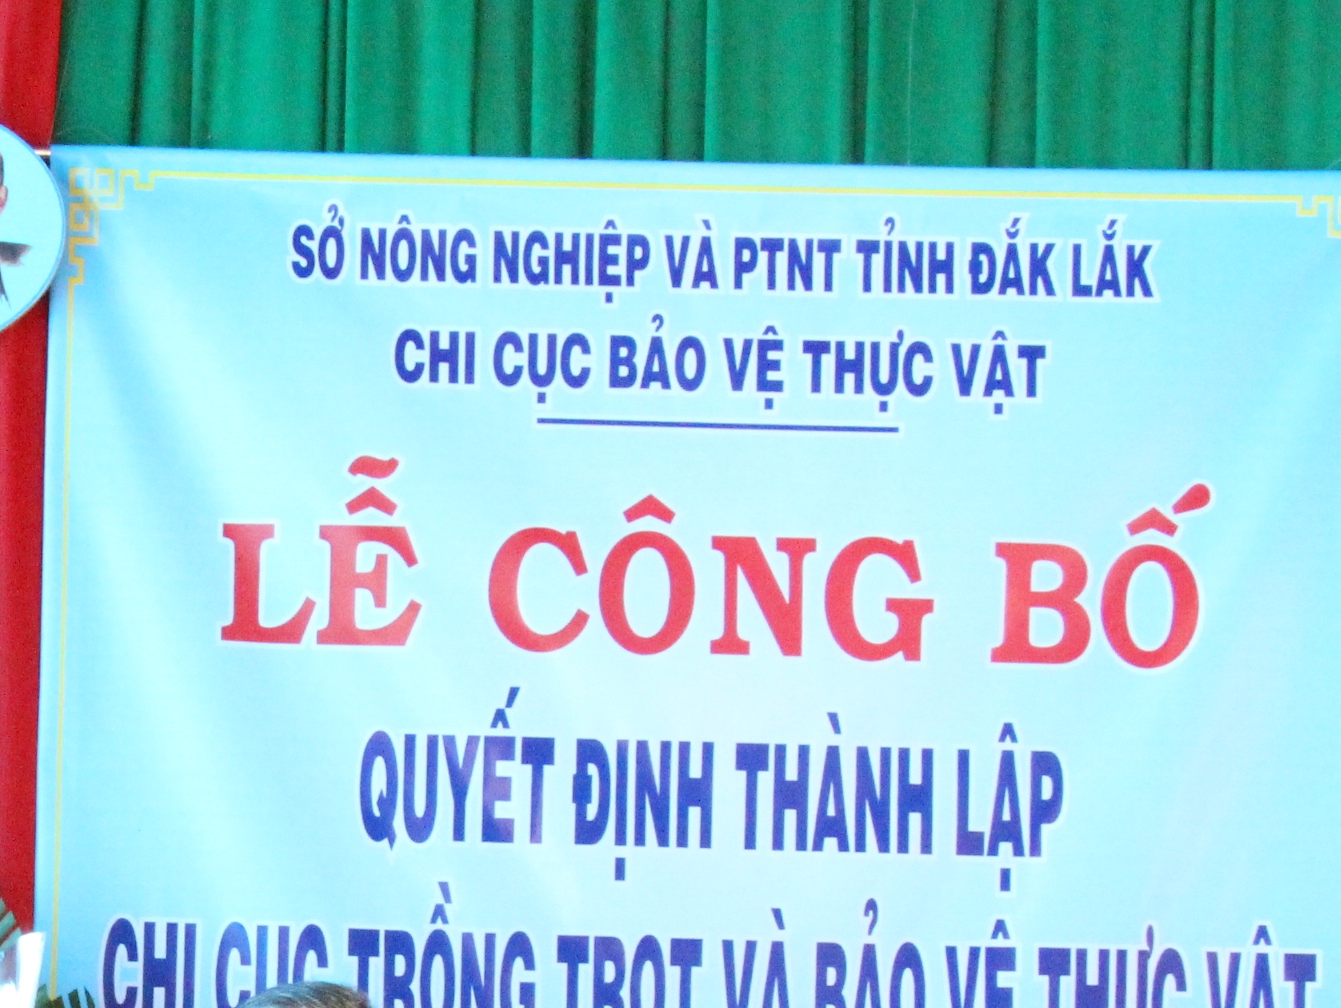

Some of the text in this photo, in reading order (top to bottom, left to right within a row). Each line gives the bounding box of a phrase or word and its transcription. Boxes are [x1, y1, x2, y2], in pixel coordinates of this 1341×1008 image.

[292, 204, 1155, 303] SỞ NÔNG NGHIỆP VÀ PTNT TỈNH ĐẮK LẮK
[395, 314, 1046, 414] CHI CỤC BẢO VỆ THỰC VẬT
[220, 455, 1211, 668] LỄ CÔNG BỐ
[359, 687, 1064, 891] QUYẾT ĐỊNH THÀNH LẬP
